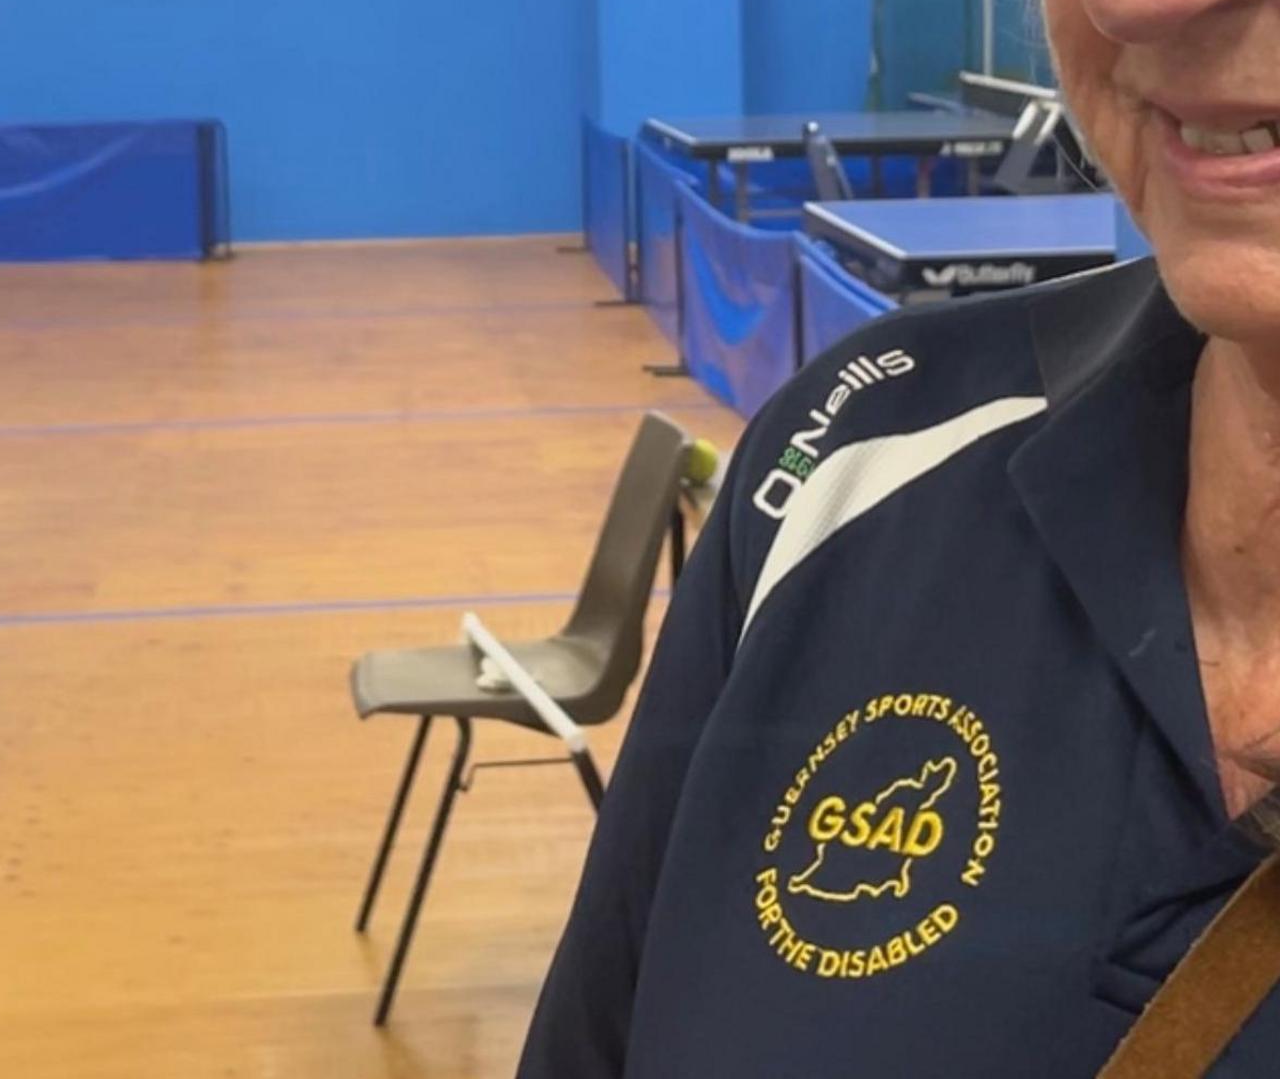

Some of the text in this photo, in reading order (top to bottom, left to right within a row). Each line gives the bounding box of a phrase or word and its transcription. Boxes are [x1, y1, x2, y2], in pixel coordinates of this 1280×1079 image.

[763, 693, 1002, 887] GUERNSEY SPORTS ASSOCIATION
[807, 795, 944, 857] GSAD
[816, 903, 959, 978] DISABLED
